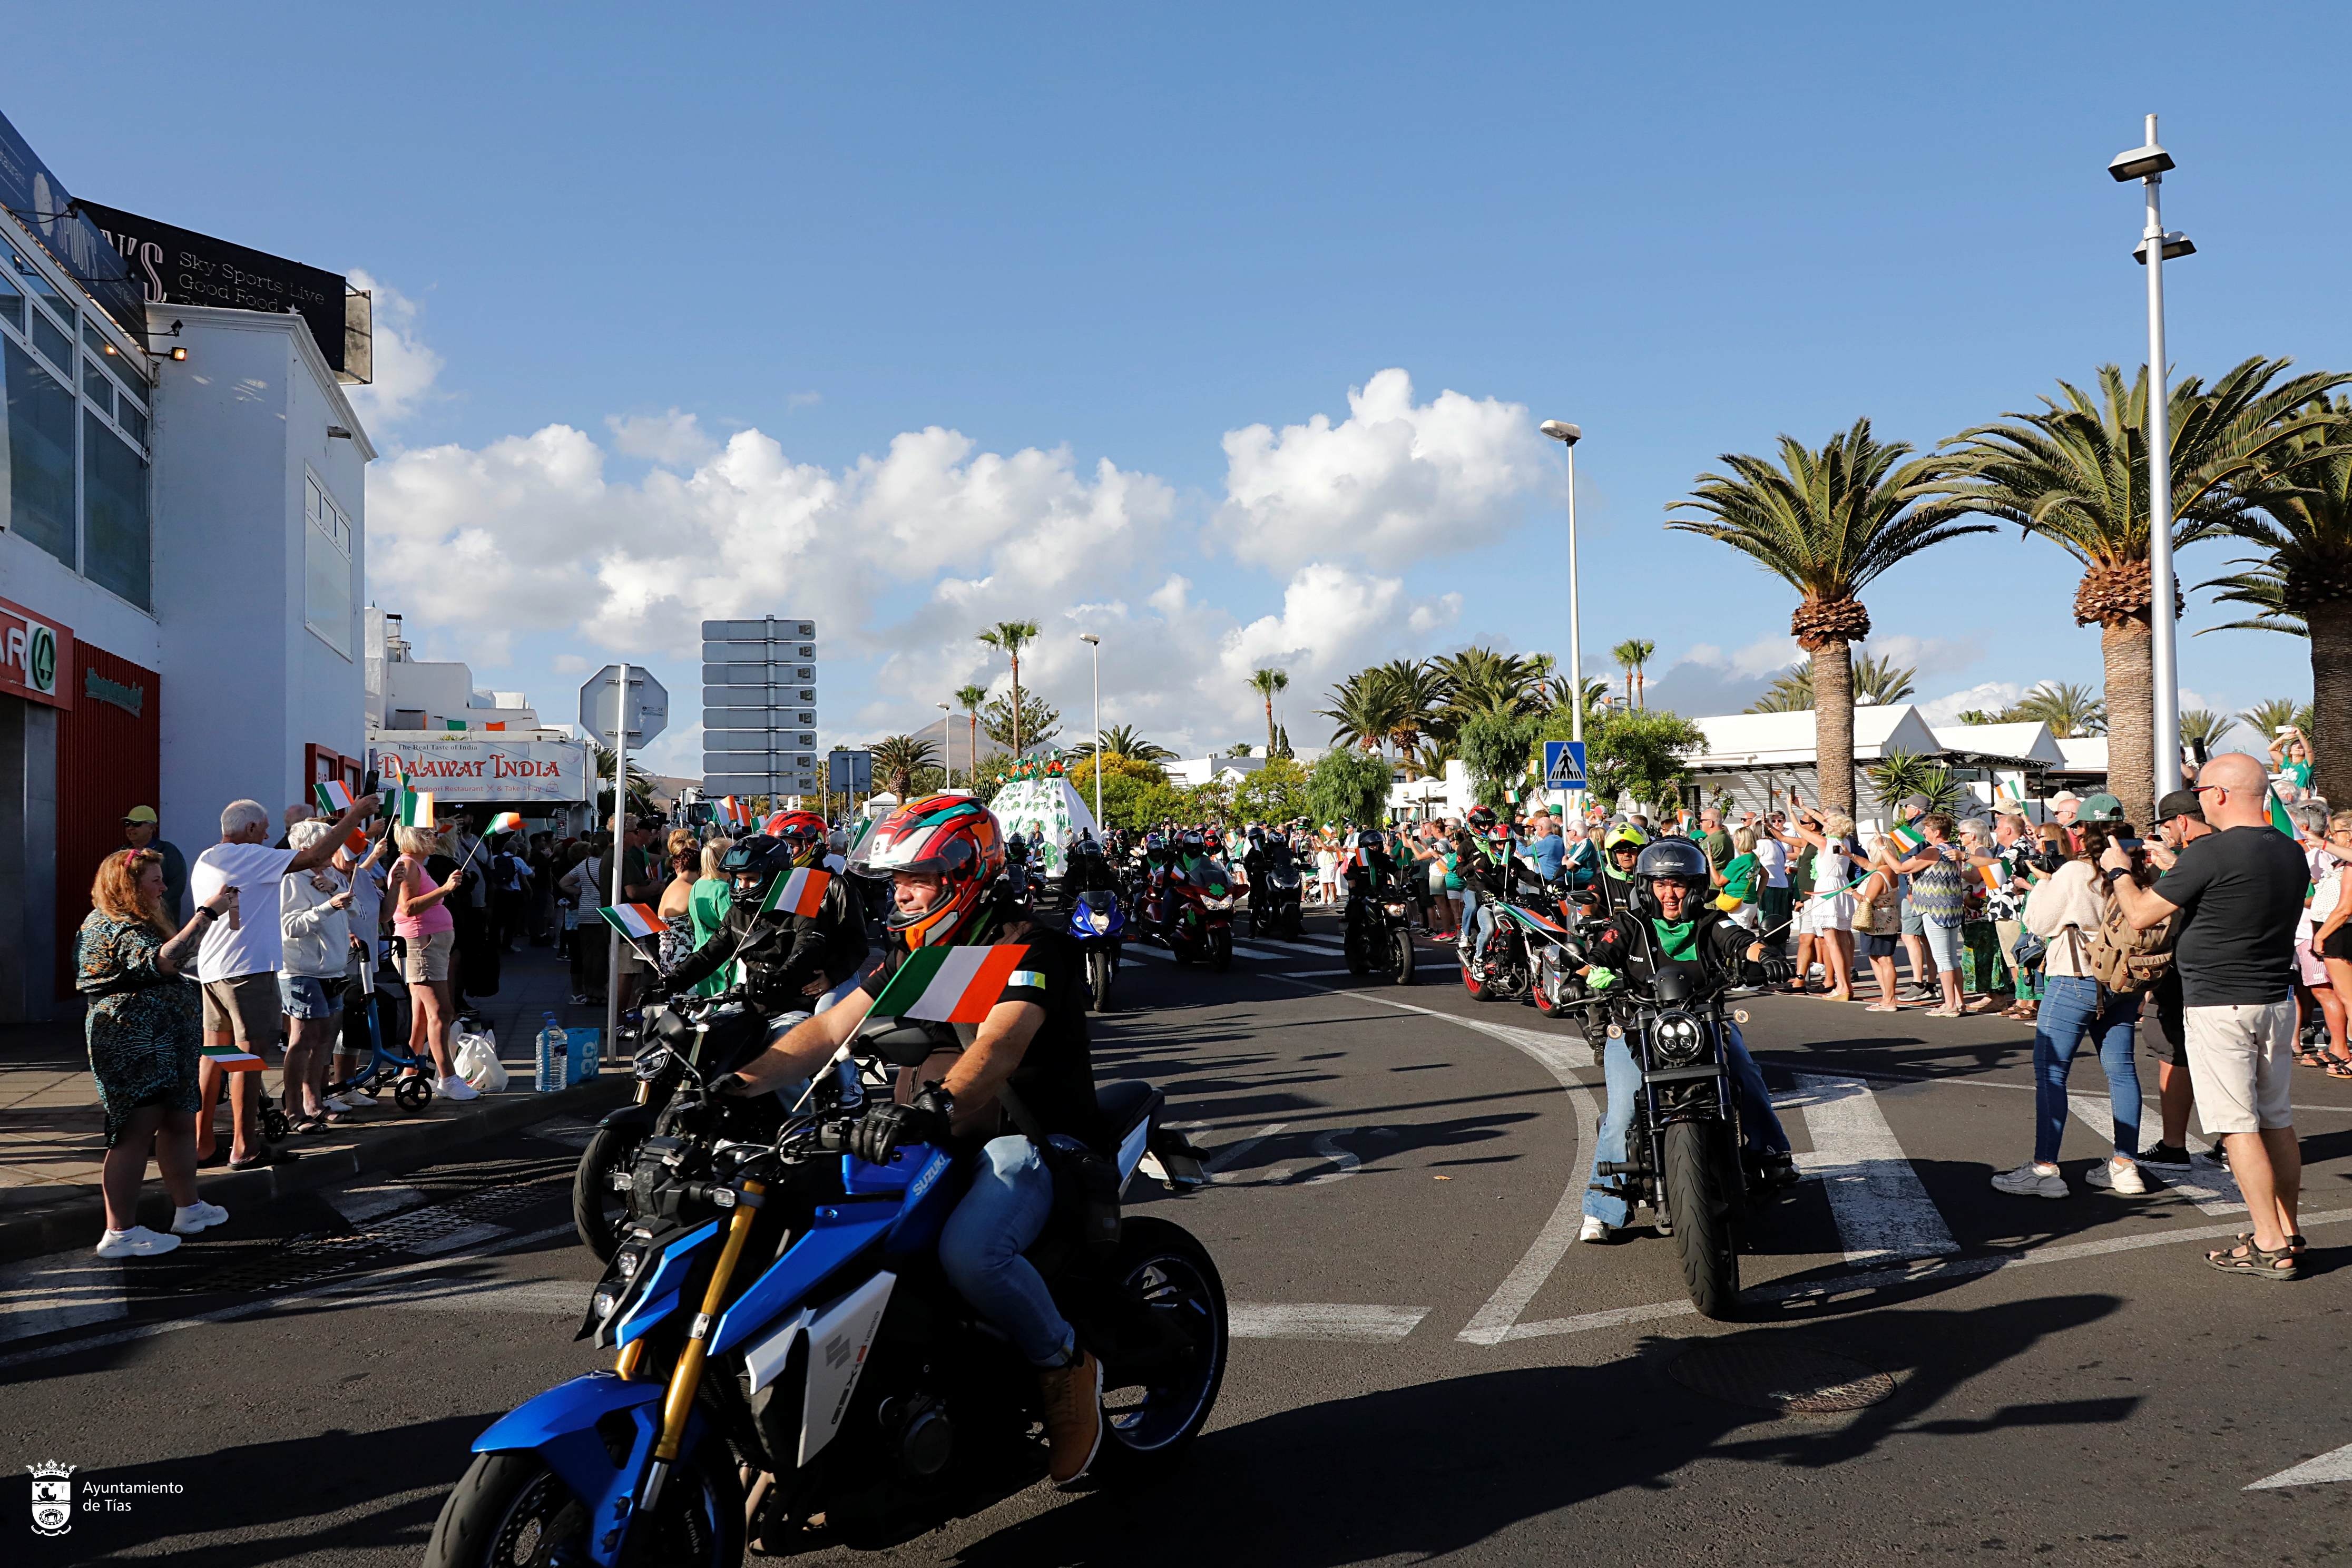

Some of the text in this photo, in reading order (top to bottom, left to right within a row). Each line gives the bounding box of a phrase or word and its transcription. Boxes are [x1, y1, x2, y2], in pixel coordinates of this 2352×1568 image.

[179, 273, 230, 300] Good
[236, 288, 278, 312] Food
[180, 252, 325, 305] Sky Sports Live
[913, 1153, 952, 1197] SUZUKI
[684, 1509, 700, 1554] brembo
